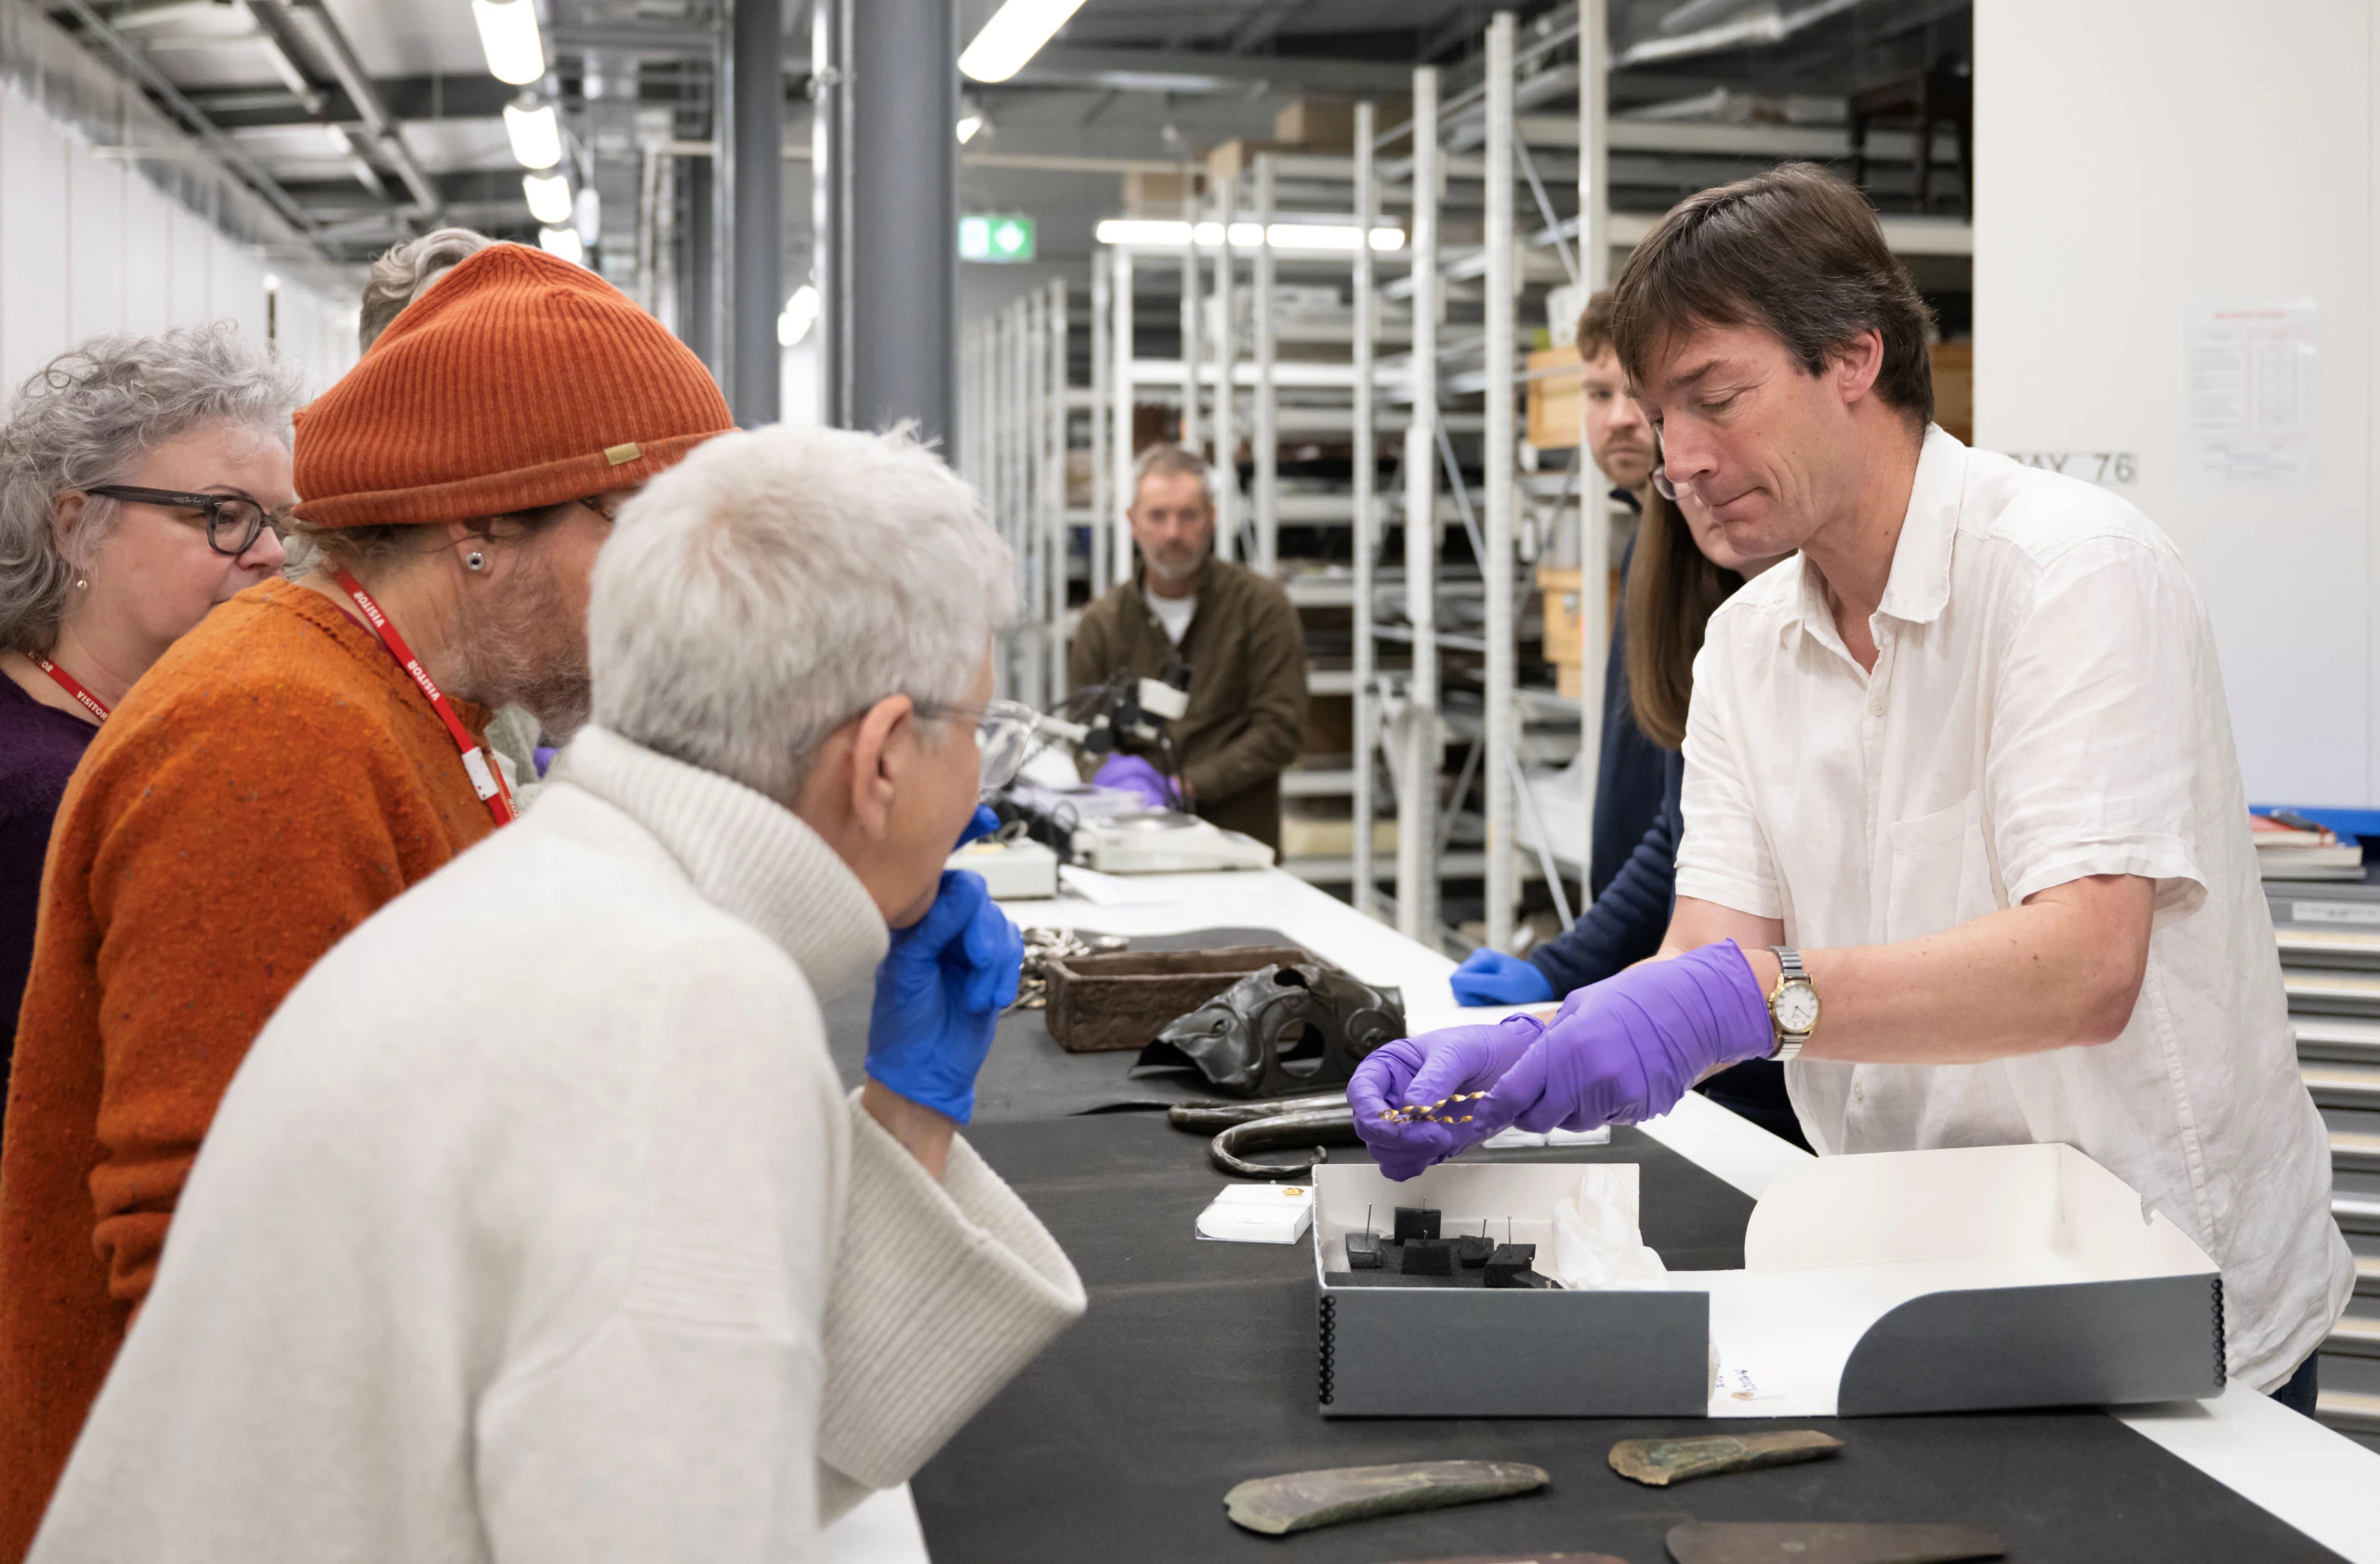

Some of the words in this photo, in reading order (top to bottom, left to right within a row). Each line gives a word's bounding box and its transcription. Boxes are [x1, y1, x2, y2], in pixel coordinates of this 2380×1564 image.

[2094, 453, 2135, 483] 76
[353, 590, 386, 628] VISITOR
[407, 659, 441, 701] VISITOR
[76, 690, 109, 721] VISITOR
